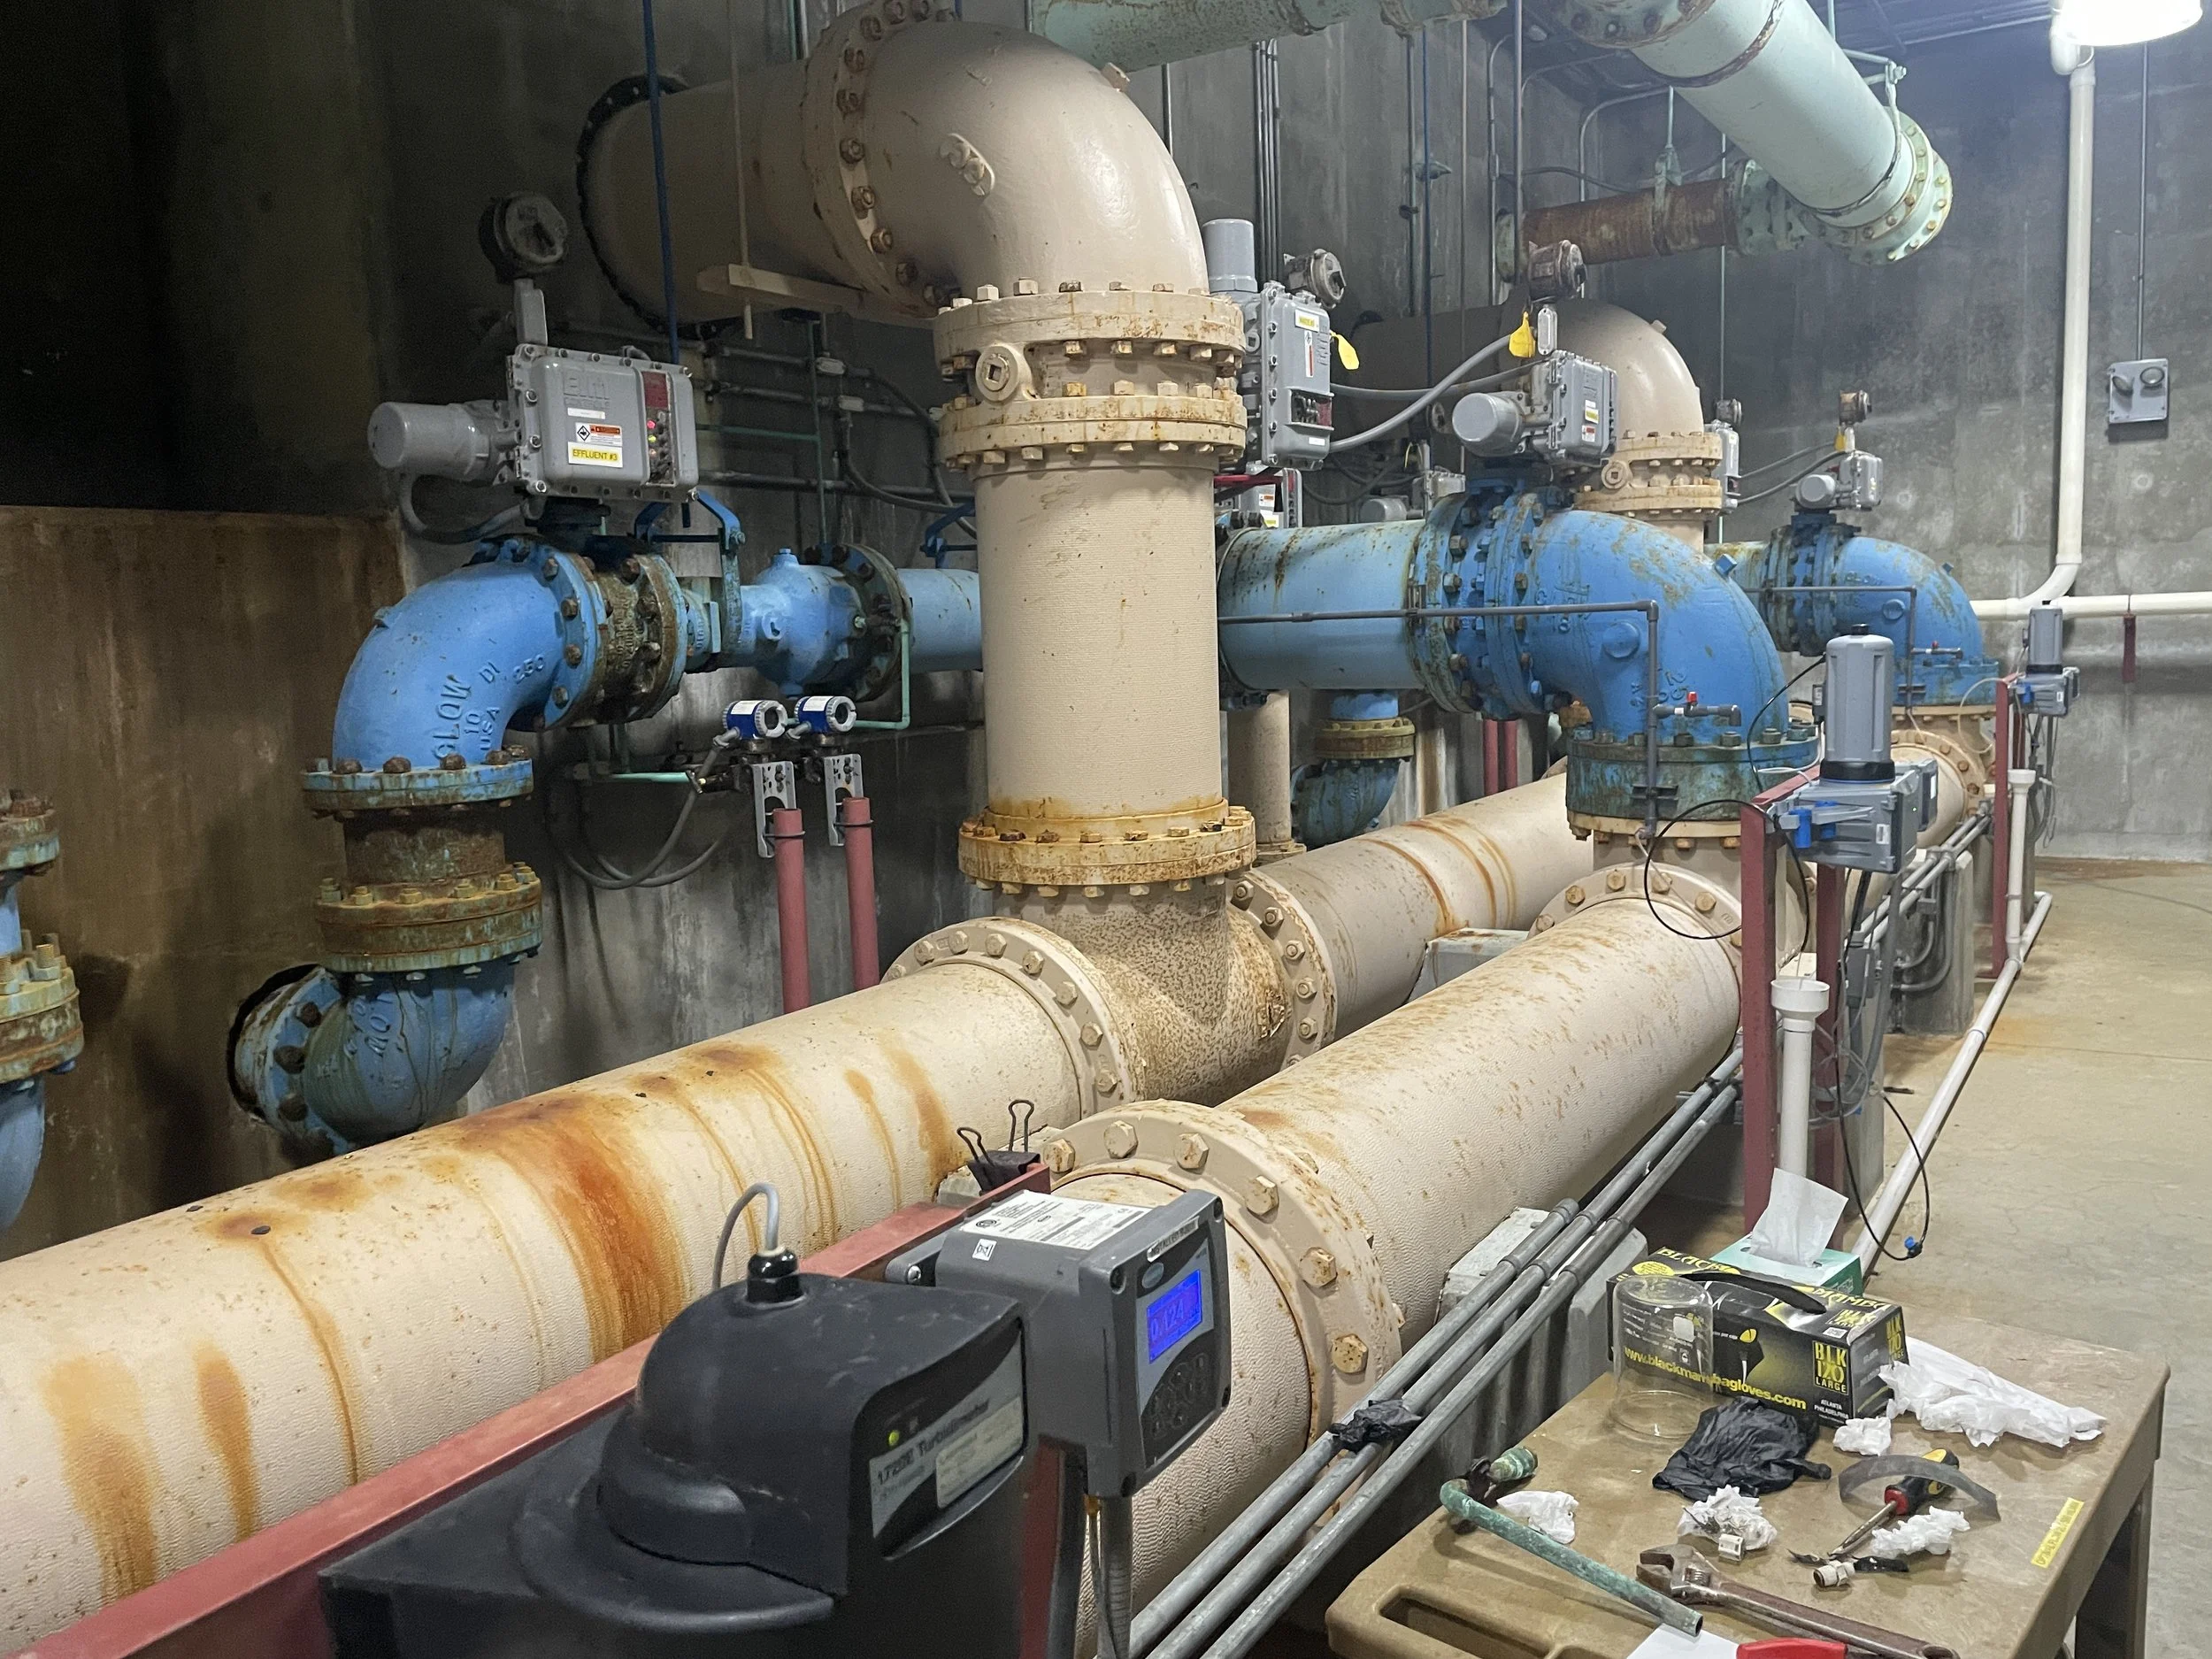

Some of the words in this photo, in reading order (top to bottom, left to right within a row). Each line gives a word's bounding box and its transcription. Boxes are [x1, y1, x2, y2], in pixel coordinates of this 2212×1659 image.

[572, 449, 608, 459] EFFLUENT
[1815, 1342, 1847, 1367] BLK
[1816, 1376, 1847, 1393] LARGE
